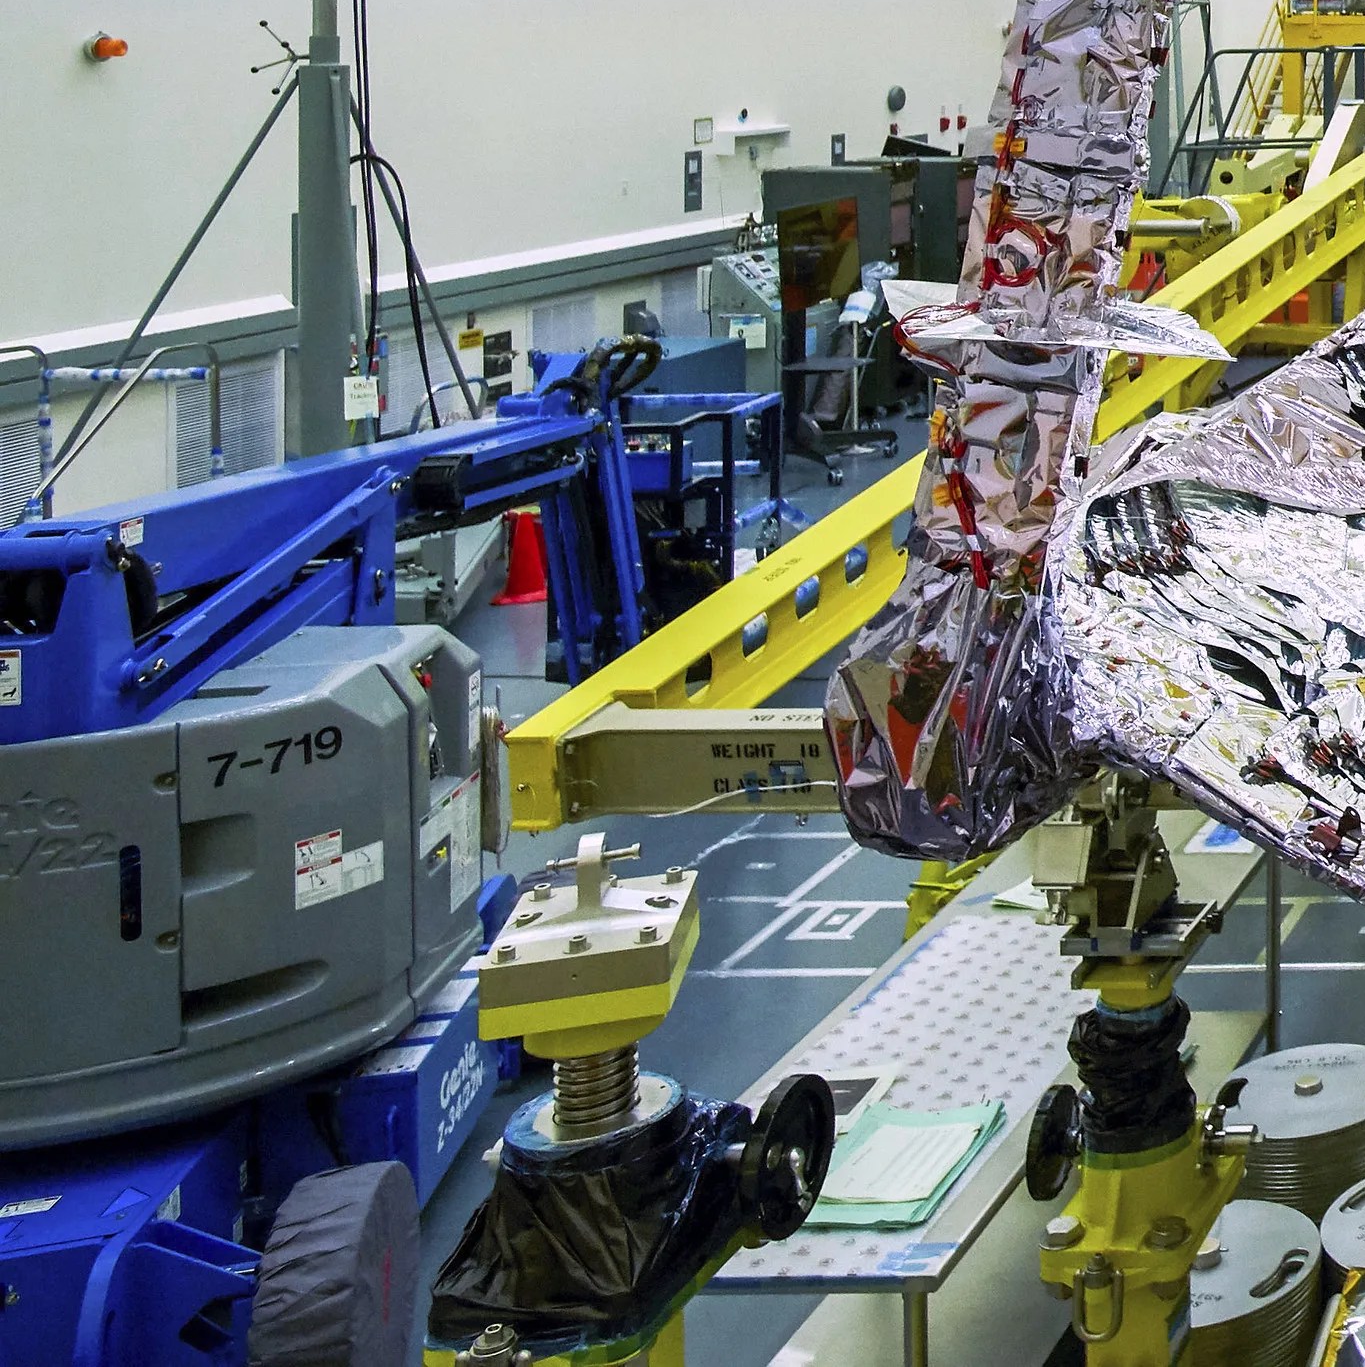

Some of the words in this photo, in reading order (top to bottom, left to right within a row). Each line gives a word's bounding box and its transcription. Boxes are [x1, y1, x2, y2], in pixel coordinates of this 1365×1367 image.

[207, 725, 344, 788] 7-719
[711, 743, 776, 759] WEIGHT
[440, 1040, 477, 1110] Genie
